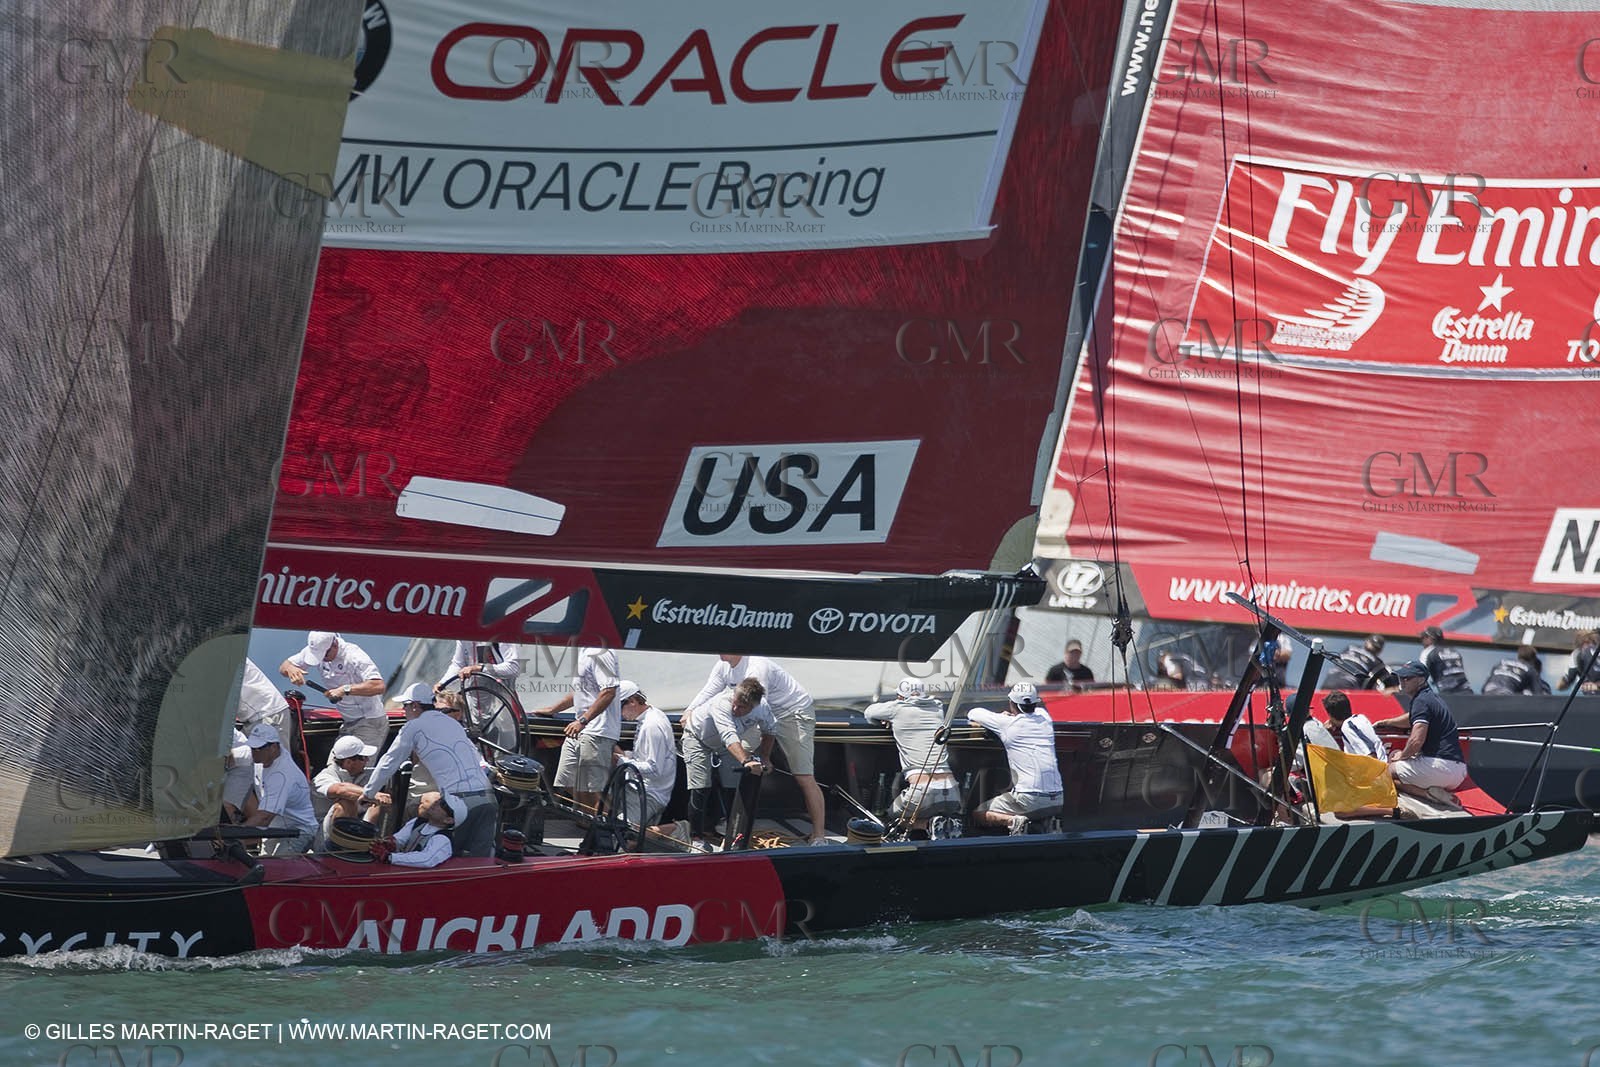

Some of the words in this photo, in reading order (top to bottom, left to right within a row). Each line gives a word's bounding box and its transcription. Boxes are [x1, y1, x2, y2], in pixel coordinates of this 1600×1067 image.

[431, 14, 964, 105] ORACLE
[443, 160, 700, 212] ORACLE
[706, 157, 886, 217] Racing
[1268, 172, 1408, 275] Fly
[1417, 188, 1600, 268] Emir
[1431, 306, 1535, 341] Estrella
[1439, 338, 1508, 363] Damm
[683, 454, 876, 535] USA
[1552, 519, 1600, 573] N
[848, 612, 937, 634] TOYOTA
[1169, 577, 1412, 618] wwwemirates.com
